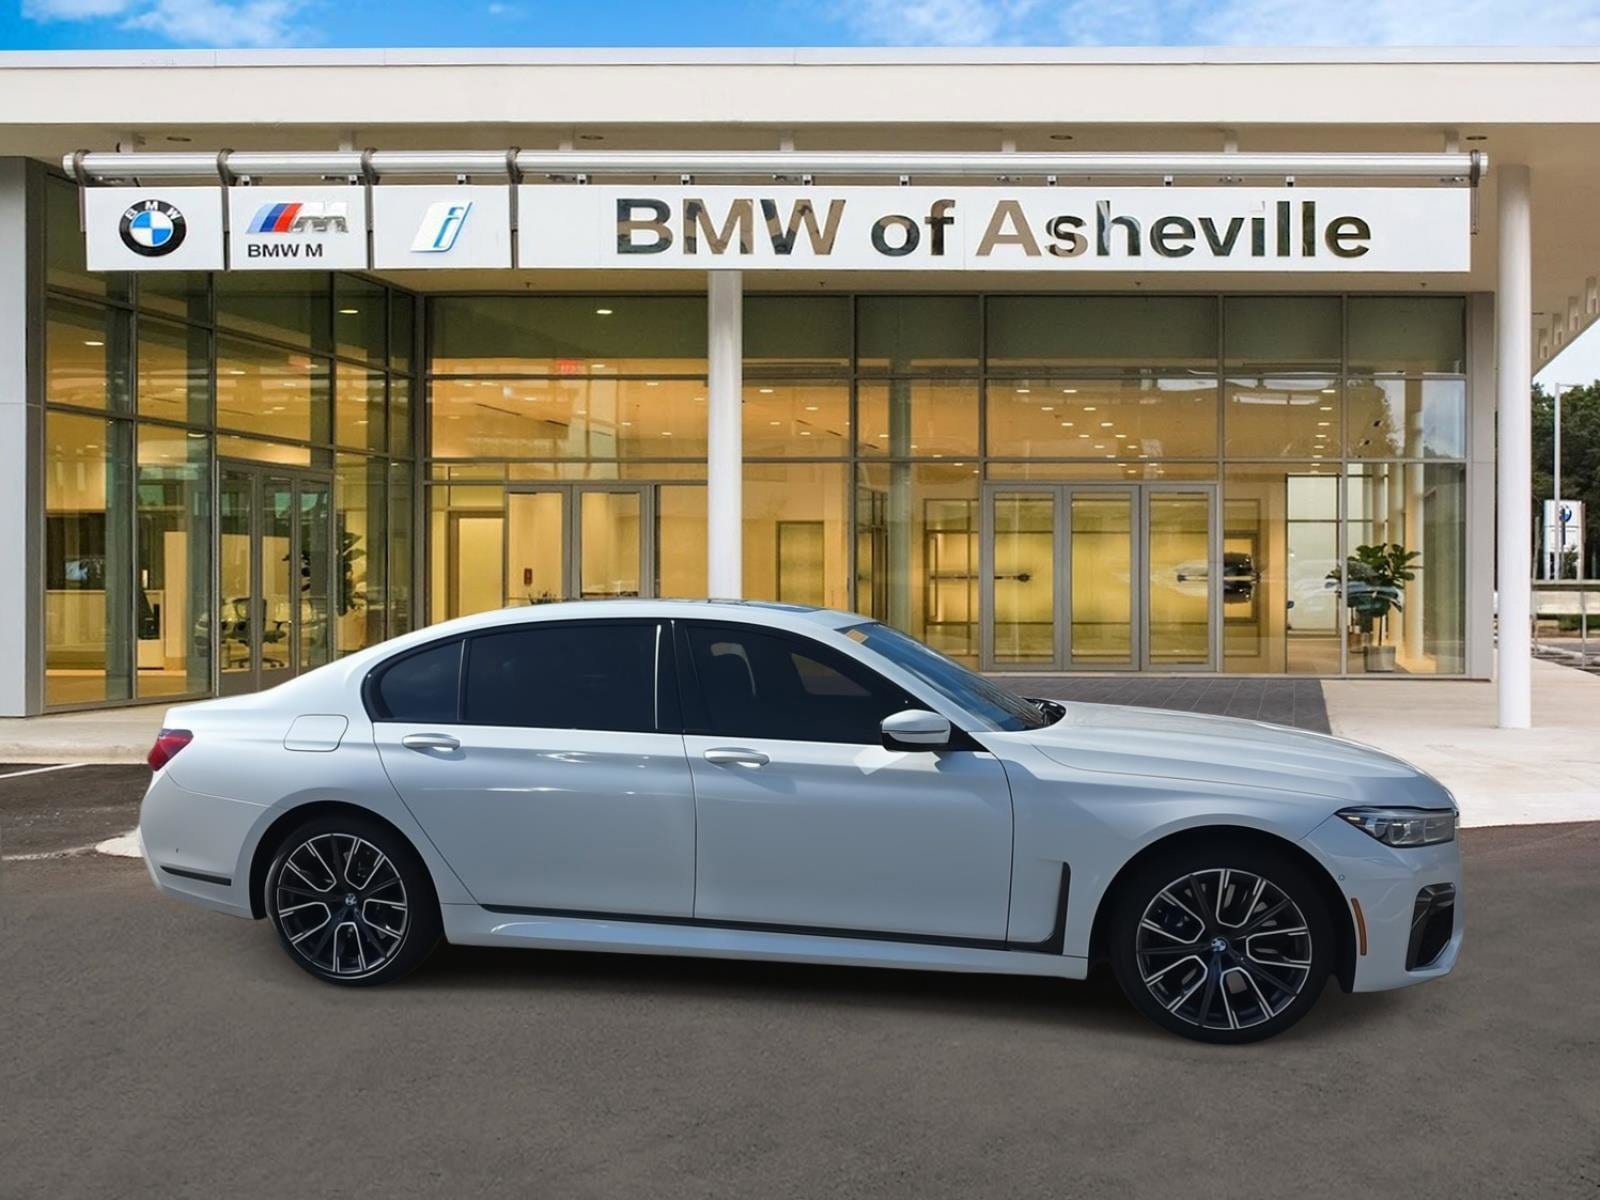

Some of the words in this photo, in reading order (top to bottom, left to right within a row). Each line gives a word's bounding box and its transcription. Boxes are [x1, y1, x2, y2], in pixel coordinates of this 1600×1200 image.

[125, 200, 181, 220] BMW
[616, 198, 846, 255] BMW
[871, 199, 956, 256] of
[976, 199, 1372, 258] Asheville
[247, 244, 300, 257] BMW
[305, 244, 323, 257] M
